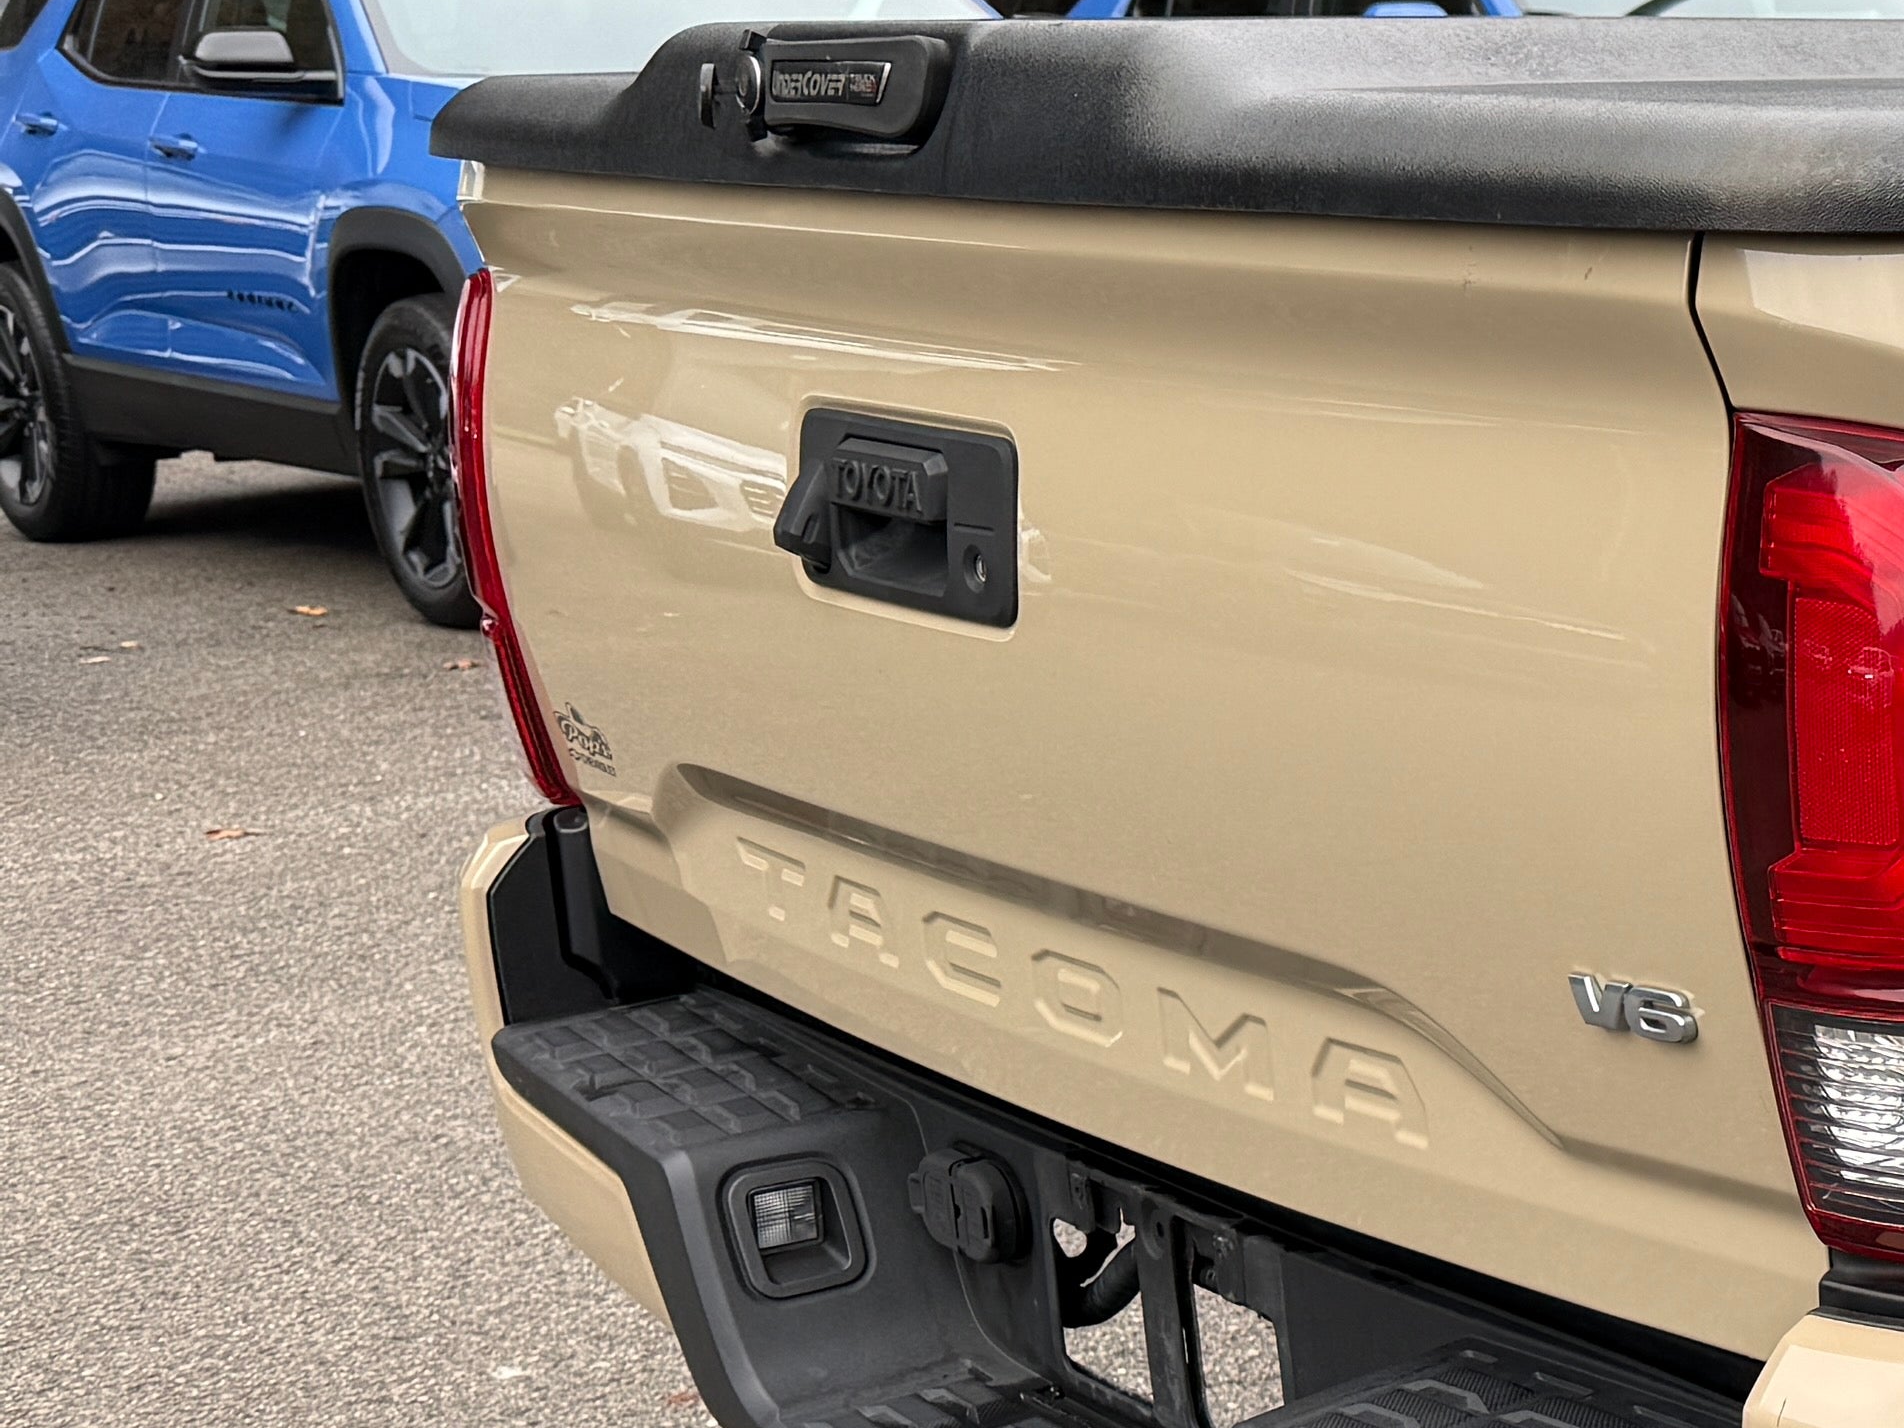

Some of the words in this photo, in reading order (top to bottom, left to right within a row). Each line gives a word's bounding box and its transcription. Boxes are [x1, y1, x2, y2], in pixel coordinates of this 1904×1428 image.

[832, 457, 924, 515] TOYOTA
[736, 835, 1429, 1150] TACOMA
[1568, 972, 1699, 1044] V6
